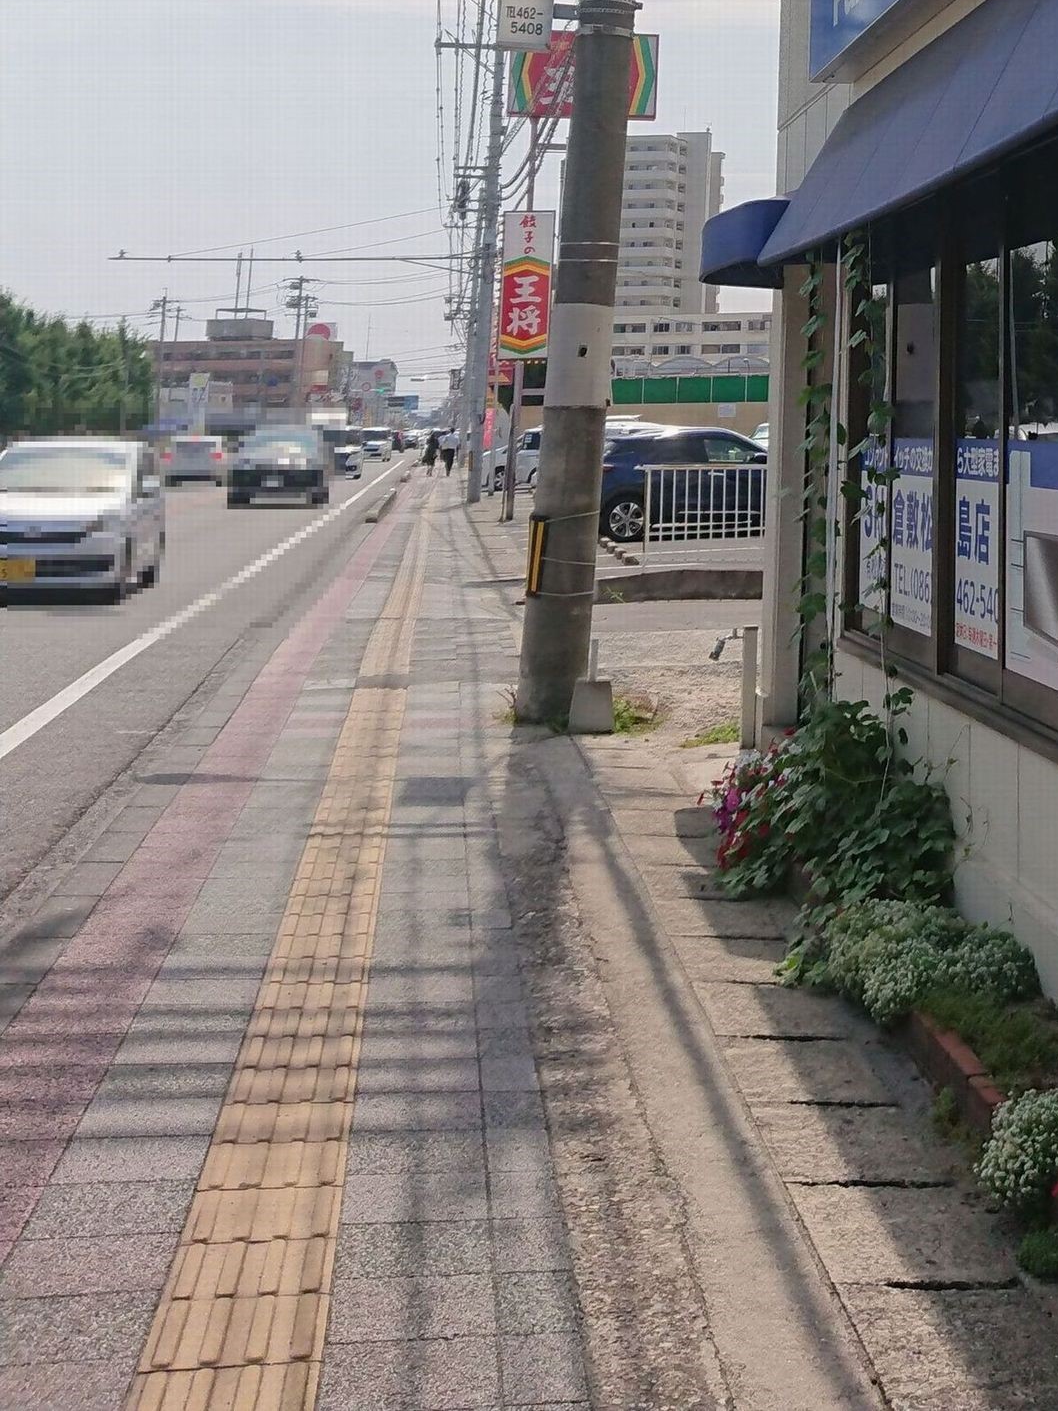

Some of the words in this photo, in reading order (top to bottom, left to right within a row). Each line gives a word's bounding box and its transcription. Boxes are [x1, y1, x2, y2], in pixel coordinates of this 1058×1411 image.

[510, 21, 543, 36] 5408
[519, 215, 537, 254] 餃子の
[506, 275, 541, 336] 王将
[957, 496, 990, 566] 島店
